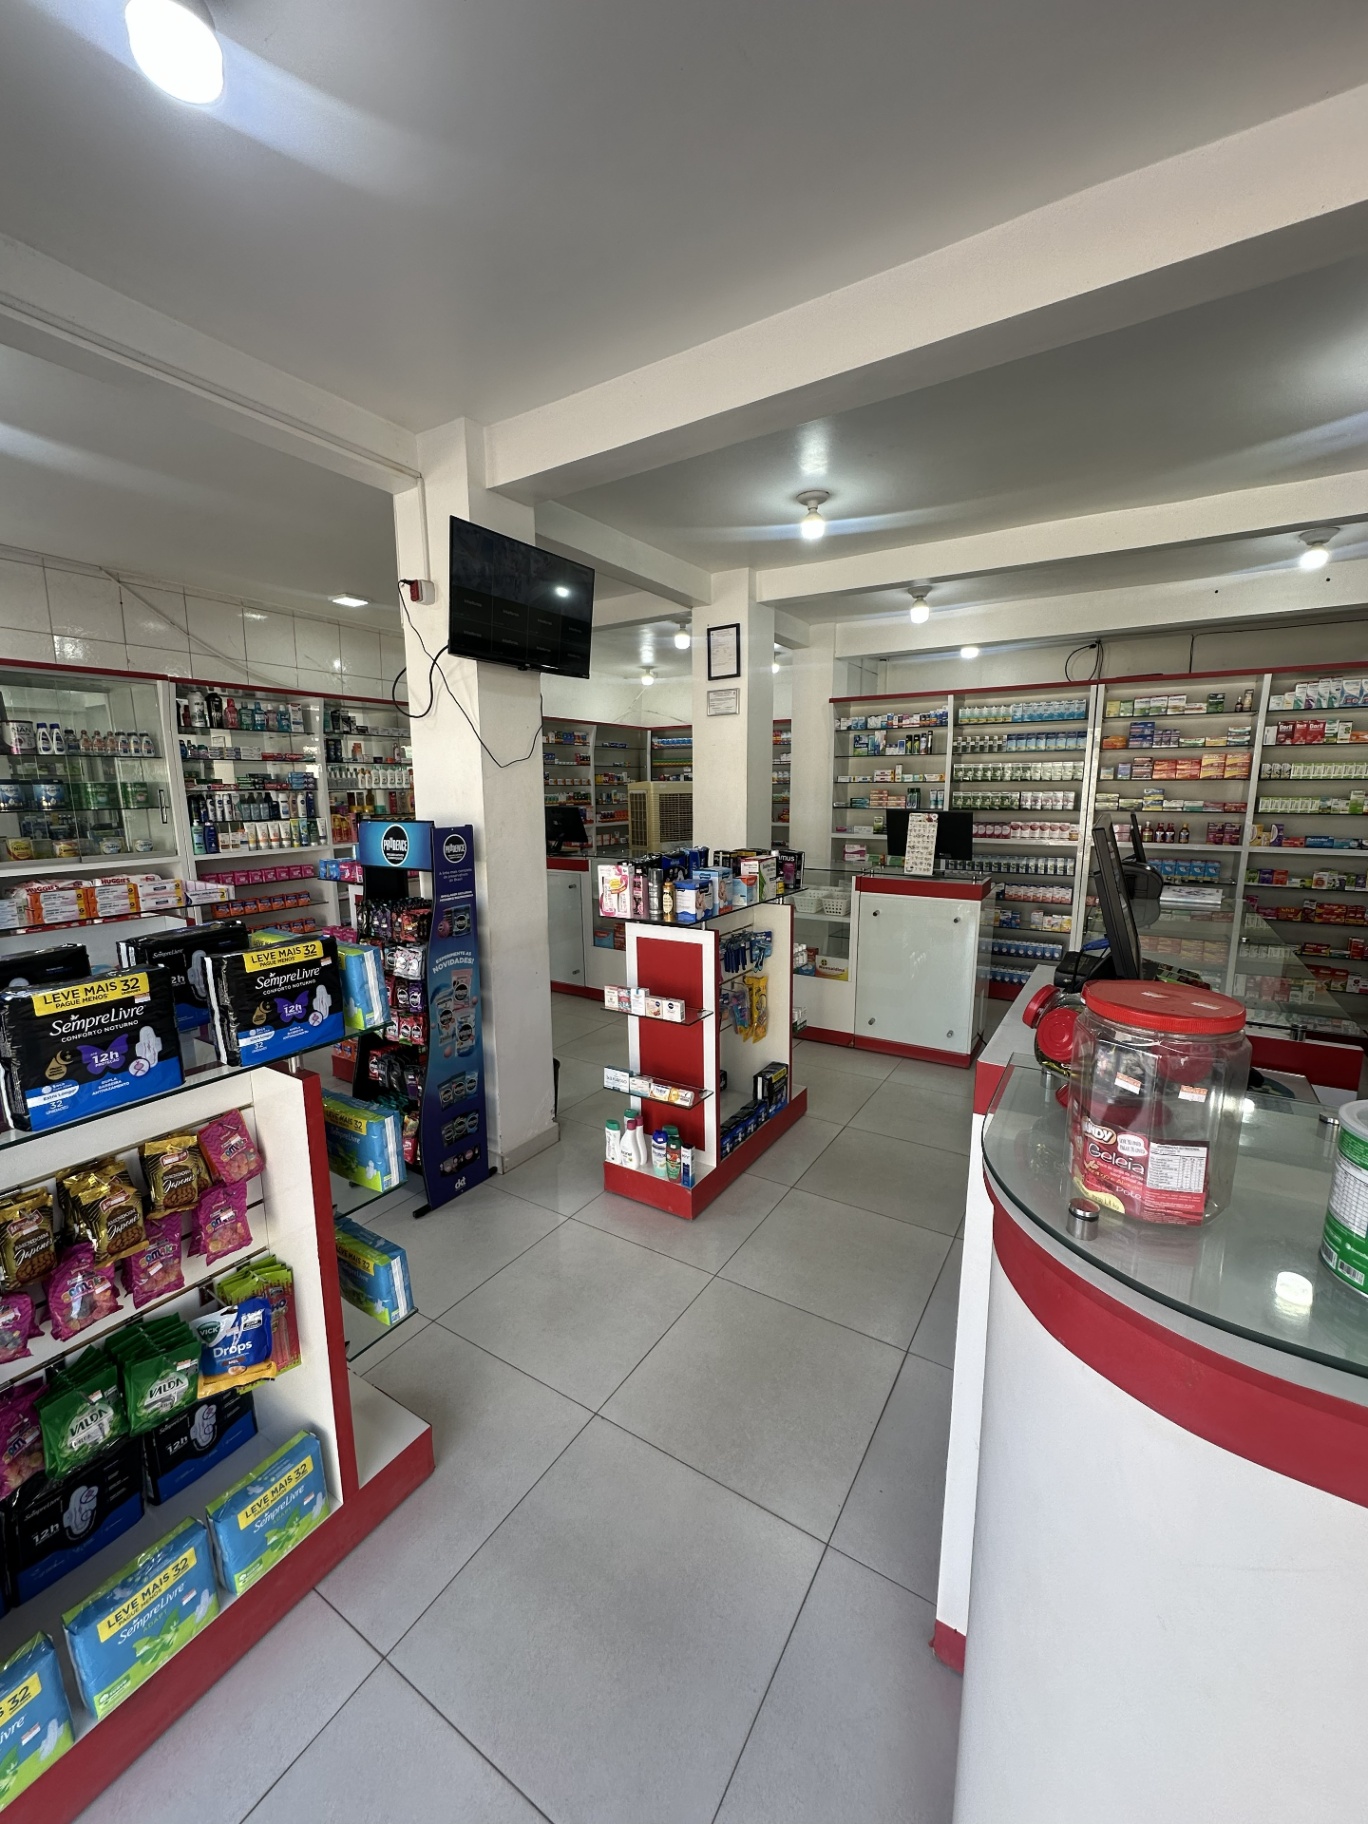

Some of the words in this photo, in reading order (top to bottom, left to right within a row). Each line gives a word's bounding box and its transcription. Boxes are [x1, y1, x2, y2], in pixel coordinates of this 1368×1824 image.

[251, 952, 276, 964] LEVE
[278, 948, 301, 959] MAIS
[303, 944, 317, 955] 32
[432, 958, 474, 974] NOVIDADES!
[255, 967, 320, 990] SempreLivre
[263, 985, 291, 996] CONFORTO
[292, 979, 316, 989] NOTURNO
[44, 989, 80, 1005] LEVE
[84, 982, 118, 996] MAIS
[120, 978, 140, 992] 32
[56, 1000, 80, 1009] PAGUE
[82, 994, 108, 1004] MENOS
[50, 1005, 144, 1036] SempreLivre
[62, 1028, 102, 1043] CONFORTO
[104, 1020, 138, 1033] NOTURNO
[92, 1050, 119, 1064] 12h
[50, 1100, 63, 1110] 32
[354, 1120, 362, 1129] 32
[1088, 1142, 1144, 1174] Geleia
[200, 1326, 218, 1336] VICK
[213, 1340, 252, 1358] Drops
[149, 1378, 184, 1398] VALDA
[70, 1408, 108, 1436] VALDA
[165, 1436, 188, 1456] 12h
[245, 1495, 270, 1518] LEVE
[271, 1476, 293, 1498] MAIS
[294, 1463, 308, 1479] 32
[253, 1485, 306, 1534] SempreLivre
[32, 1523, 60, 1546] 12h
[107, 1598, 139, 1629] LEVE
[141, 1572, 170, 1601] MAIS
[172, 1557, 189, 1578] 32
[118, 1607, 140, 1626] PAGUE
[140, 1588, 162, 1607] MENOS
[118, 1581, 185, 1645] SempreLivre
[142, 1608, 168, 1632] ADAPT
[8, 1686, 31, 1712] 32
